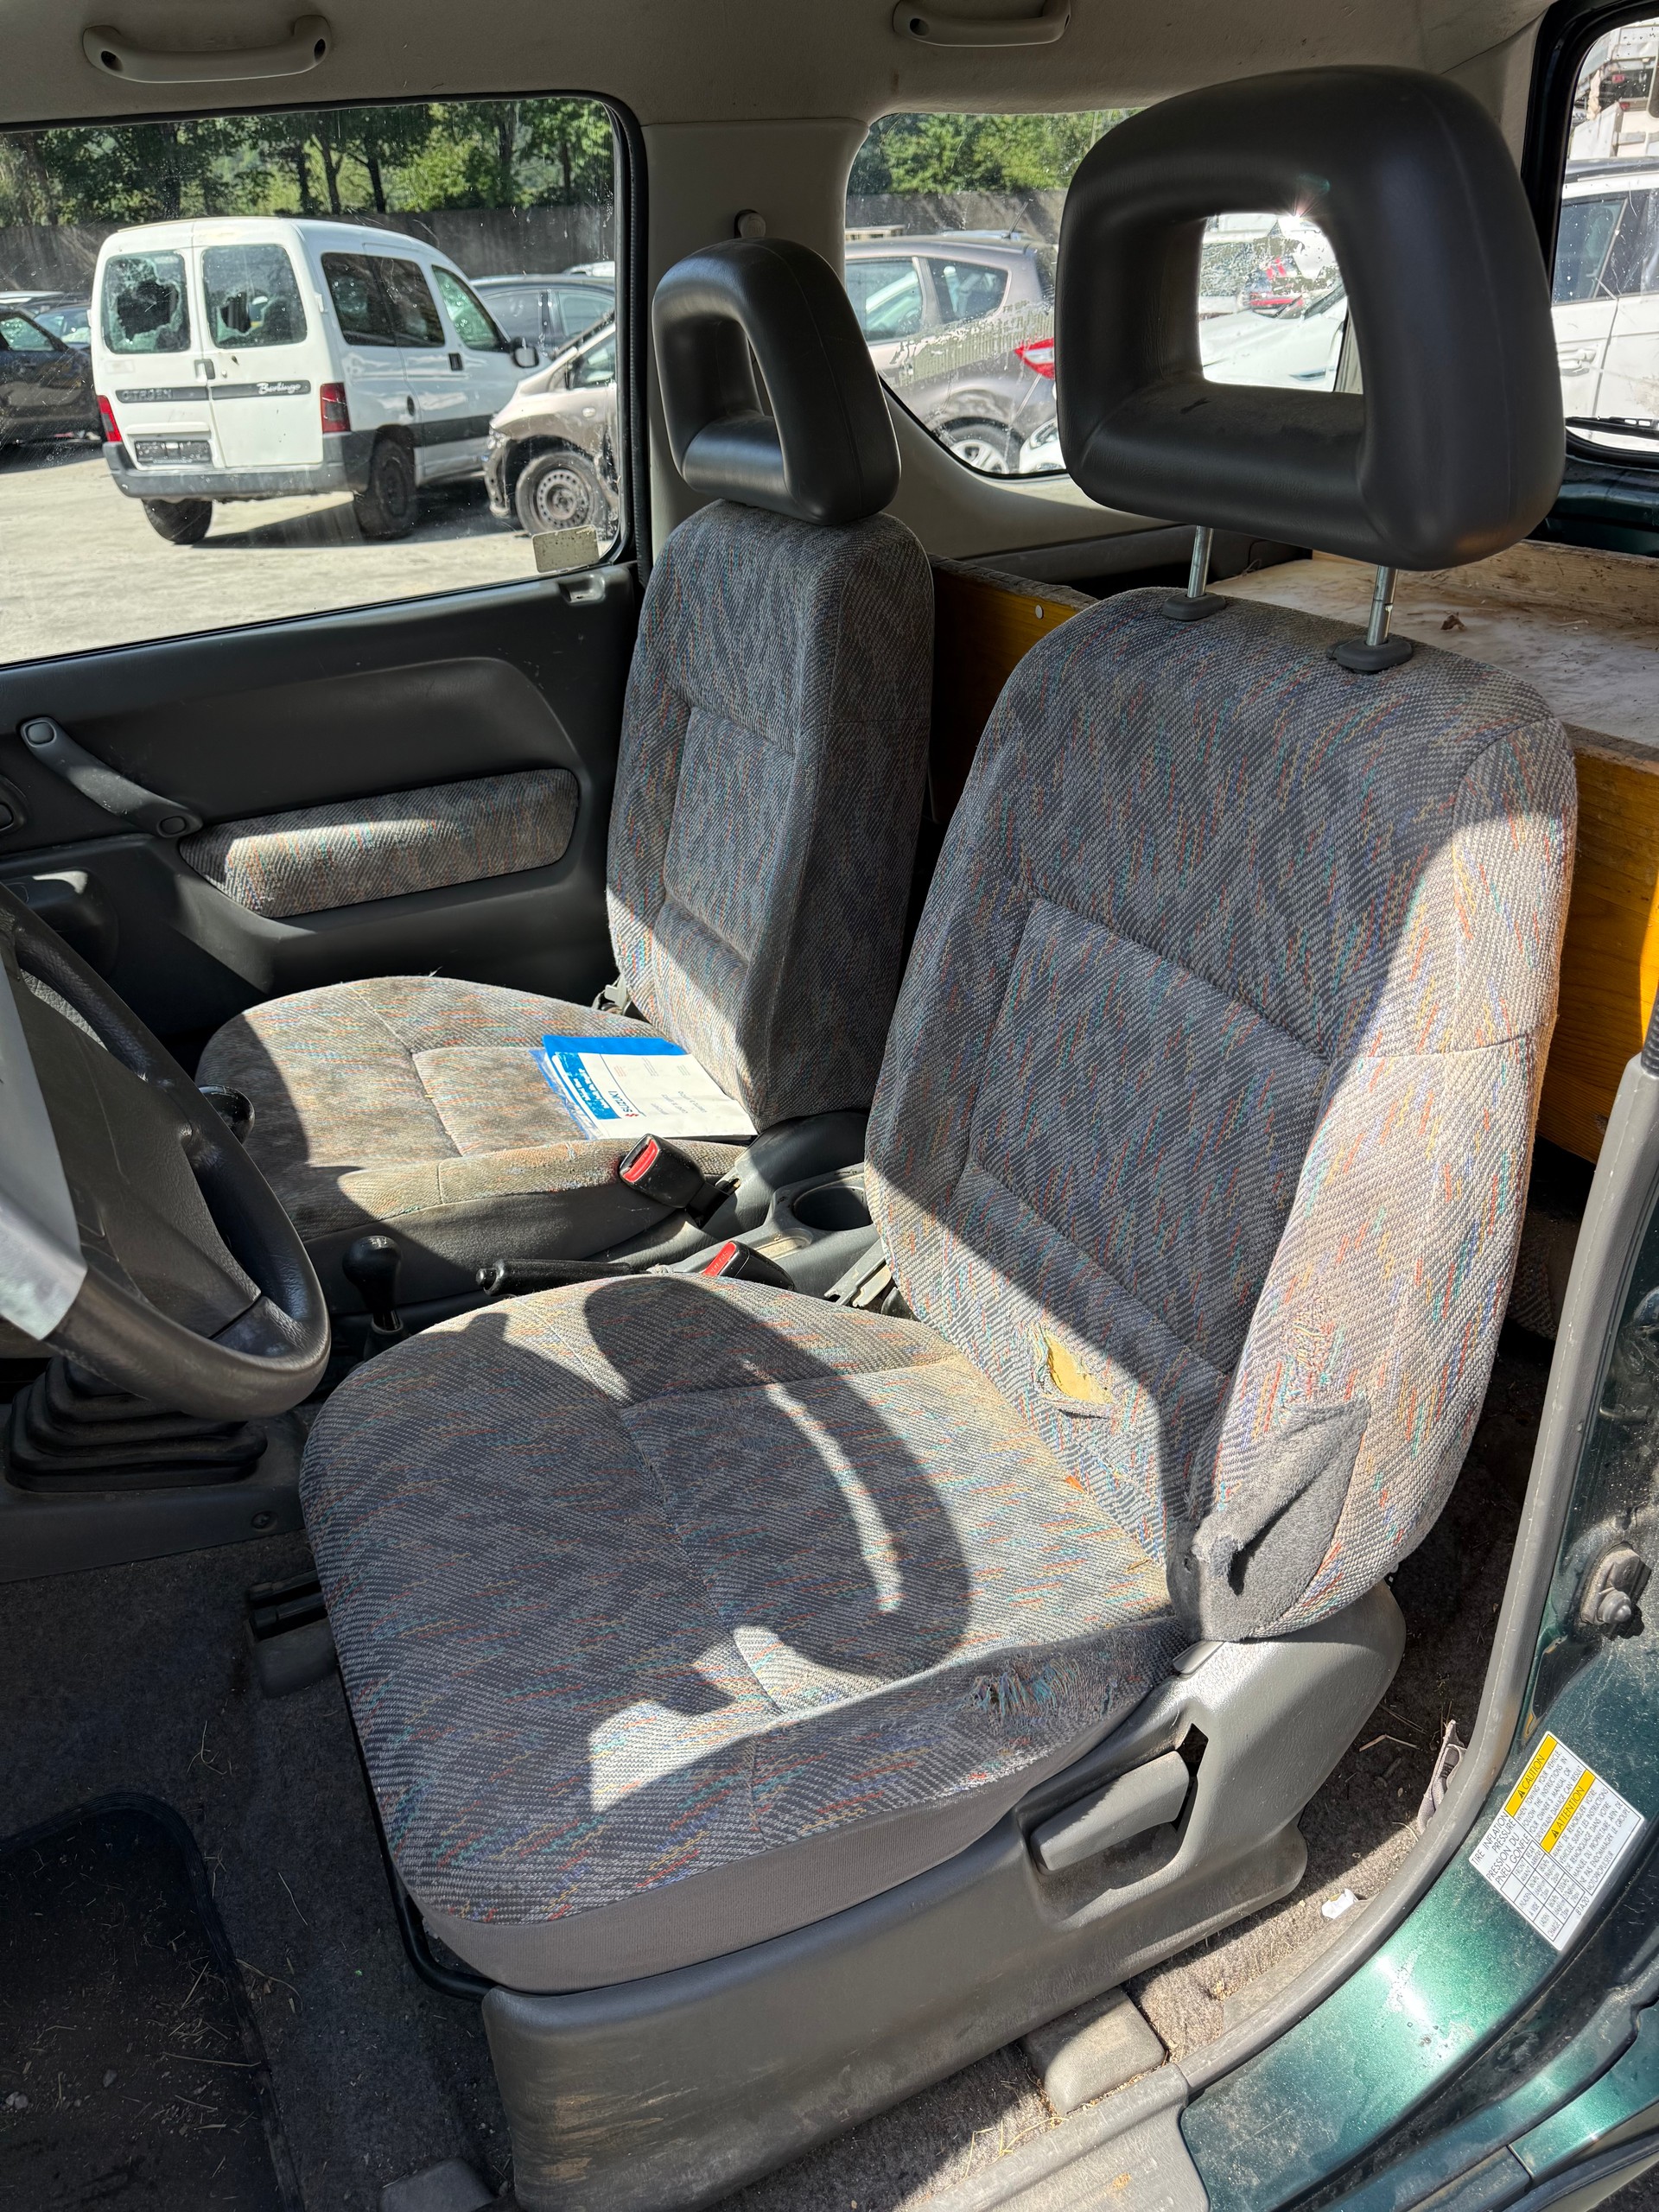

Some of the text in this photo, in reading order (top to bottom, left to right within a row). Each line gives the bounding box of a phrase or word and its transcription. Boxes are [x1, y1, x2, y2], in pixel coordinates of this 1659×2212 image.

[257, 382, 302, 395] Berlingo
[607, 1090, 633, 1113] SUZUKI
[1515, 1805, 1527, 1821] WHEN
[1524, 1783, 1540, 1805] TOWING
[1537, 1770, 1548, 1784] YOUR
[1520, 1753, 1546, 1790] CAUTION
[1522, 1755, 1567, 1828] FOLLOW THE INSTRUCTIONS IN
[1528, 1820, 1539, 1834] YOUR
[1550, 1776, 1566, 1797] MANUAL
[1562, 1766, 1571, 1777] OR
[1534, 1764, 1583, 1841] DRIVETRAIN DAMAGE CAN RESULT
[1551, 1788, 1597, 1858] AVANT DE REMORQUER VOTRE
[1554, 1785, 1585, 1830] ATTENTION
[1580, 1818, 1589, 1828] LES
[1586, 1787, 1609, 1820] INSTRUCTIONS
[1471, 1810, 1509, 1866] TIRE INFLATION
[1485, 1831, 1520, 1882] PRESSION DU
[1491, 1817, 1516, 1853] PRESSURE
[1495, 1833, 1530, 1885] PNEU GONFLE
[1525, 1845, 1535, 1859] REAR
[1564, 1801, 1611, 1872] DE REMORQUAGE DANS VOTRE
[1572, 1857, 1586, 1878] MANUEL
[1584, 1848, 1592, 1859] DU
[1606, 1807, 1618, 1821] AFIN
[1614, 1800, 1623, 1809] DE
[1579, 1807, 1630, 1885] NE PAS ENDOMMAGER LE GROUPE
[1514, 1859, 1526, 1877] FRONT
[1520, 1865, 1532, 1882] AVANT
